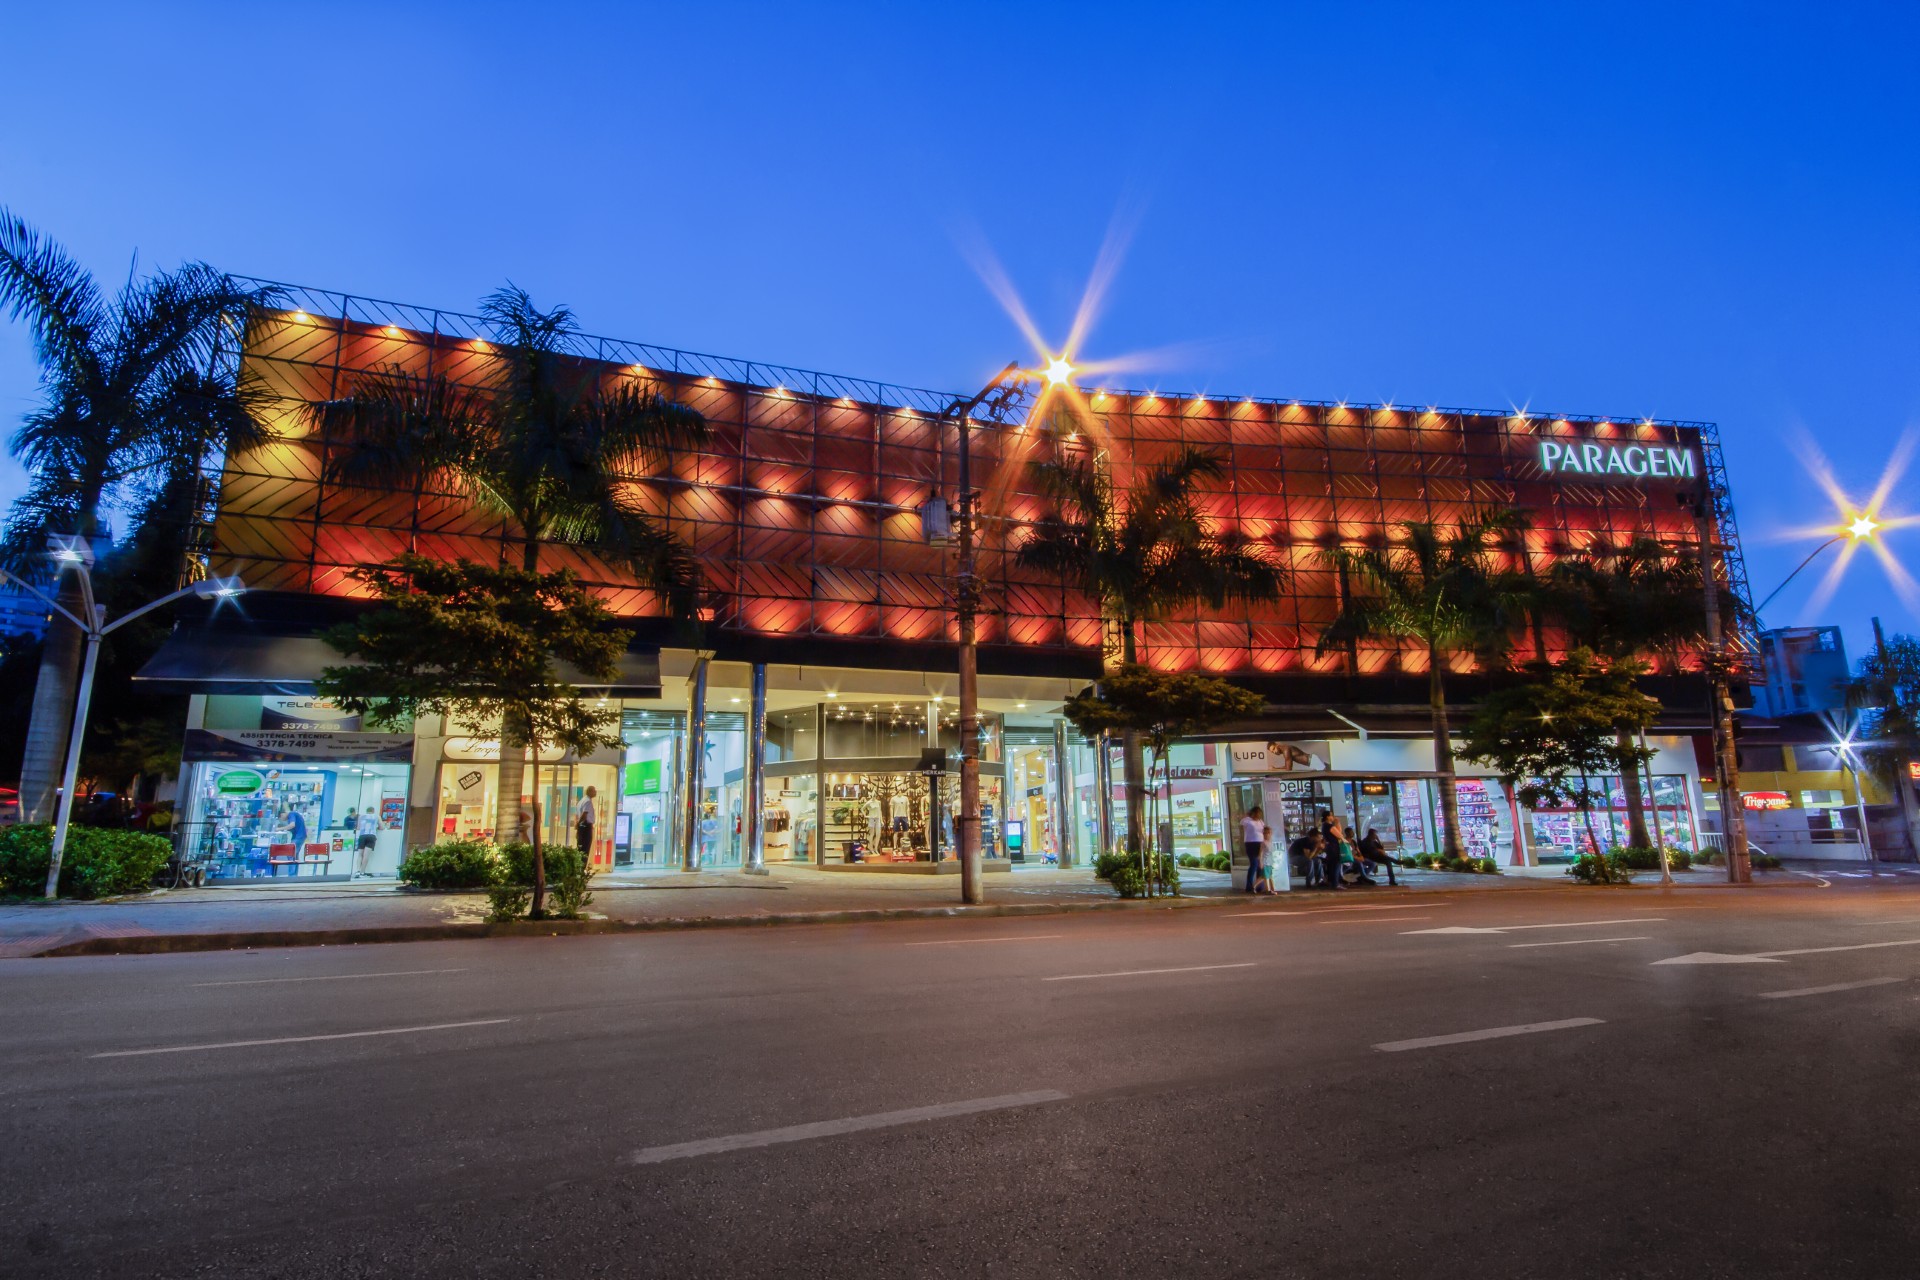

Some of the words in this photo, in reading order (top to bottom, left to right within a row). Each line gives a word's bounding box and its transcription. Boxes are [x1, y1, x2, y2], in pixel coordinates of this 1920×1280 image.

[1539, 441, 1695, 477] PARAGEM
[281, 722, 340, 731] 3378-7499
[256, 740, 316, 748] 3378-7499
[1234, 751, 1265, 762] LUPO
[1180, 768, 1213, 778] express
